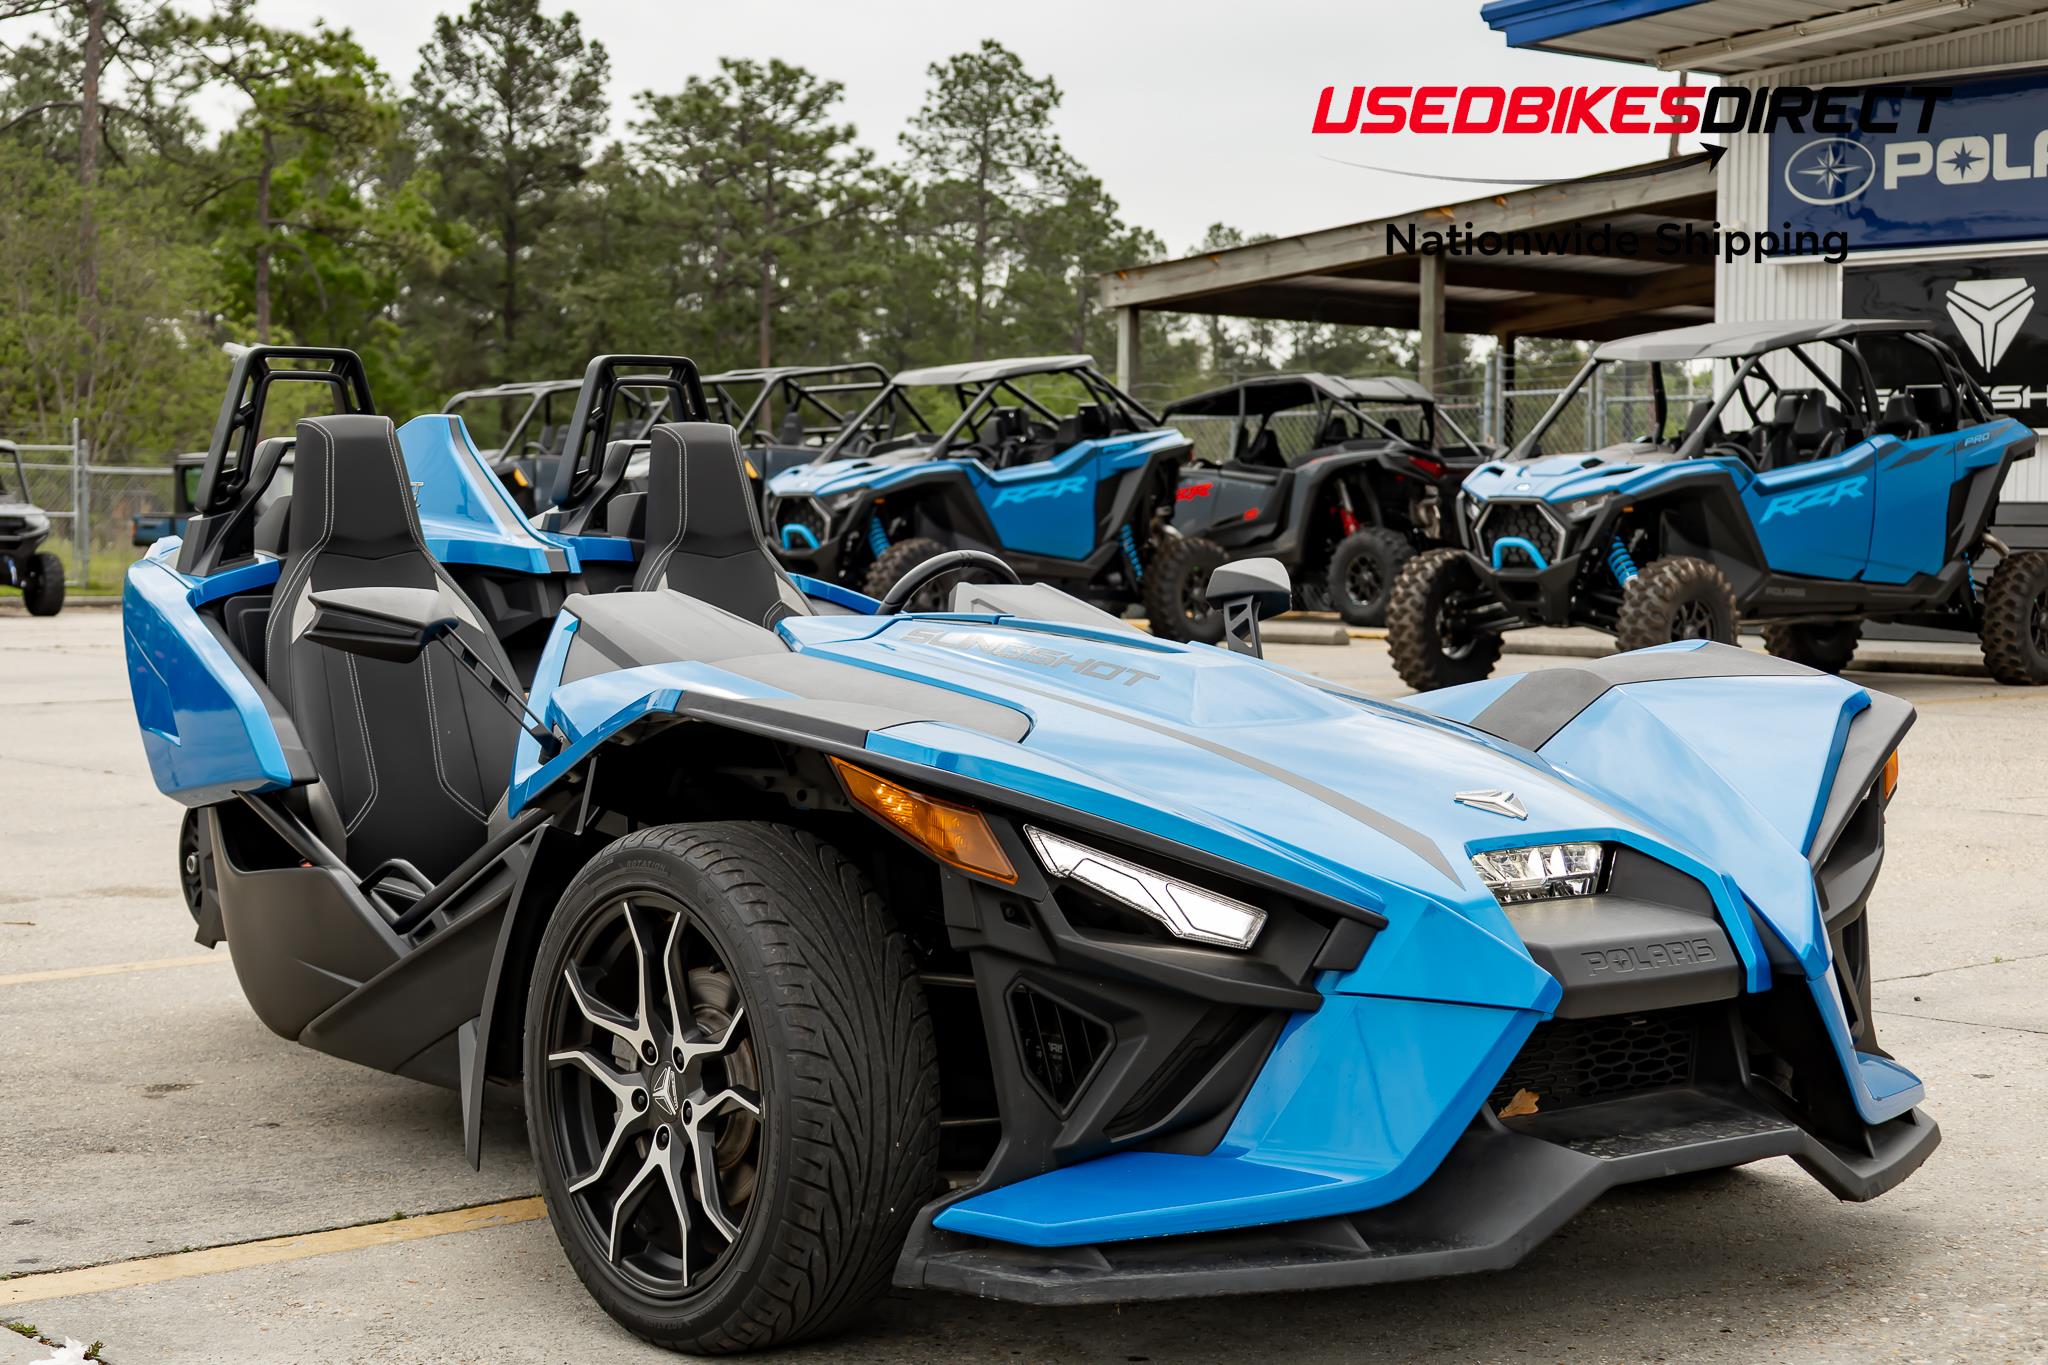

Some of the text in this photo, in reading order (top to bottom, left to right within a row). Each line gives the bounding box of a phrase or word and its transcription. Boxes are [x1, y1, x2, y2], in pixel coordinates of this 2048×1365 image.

[1884, 129, 2048, 190] POL
[991, 476, 1088, 508] RZR
[1758, 475, 1868, 524] RZR
[1580, 938, 1717, 977] POLARIS
